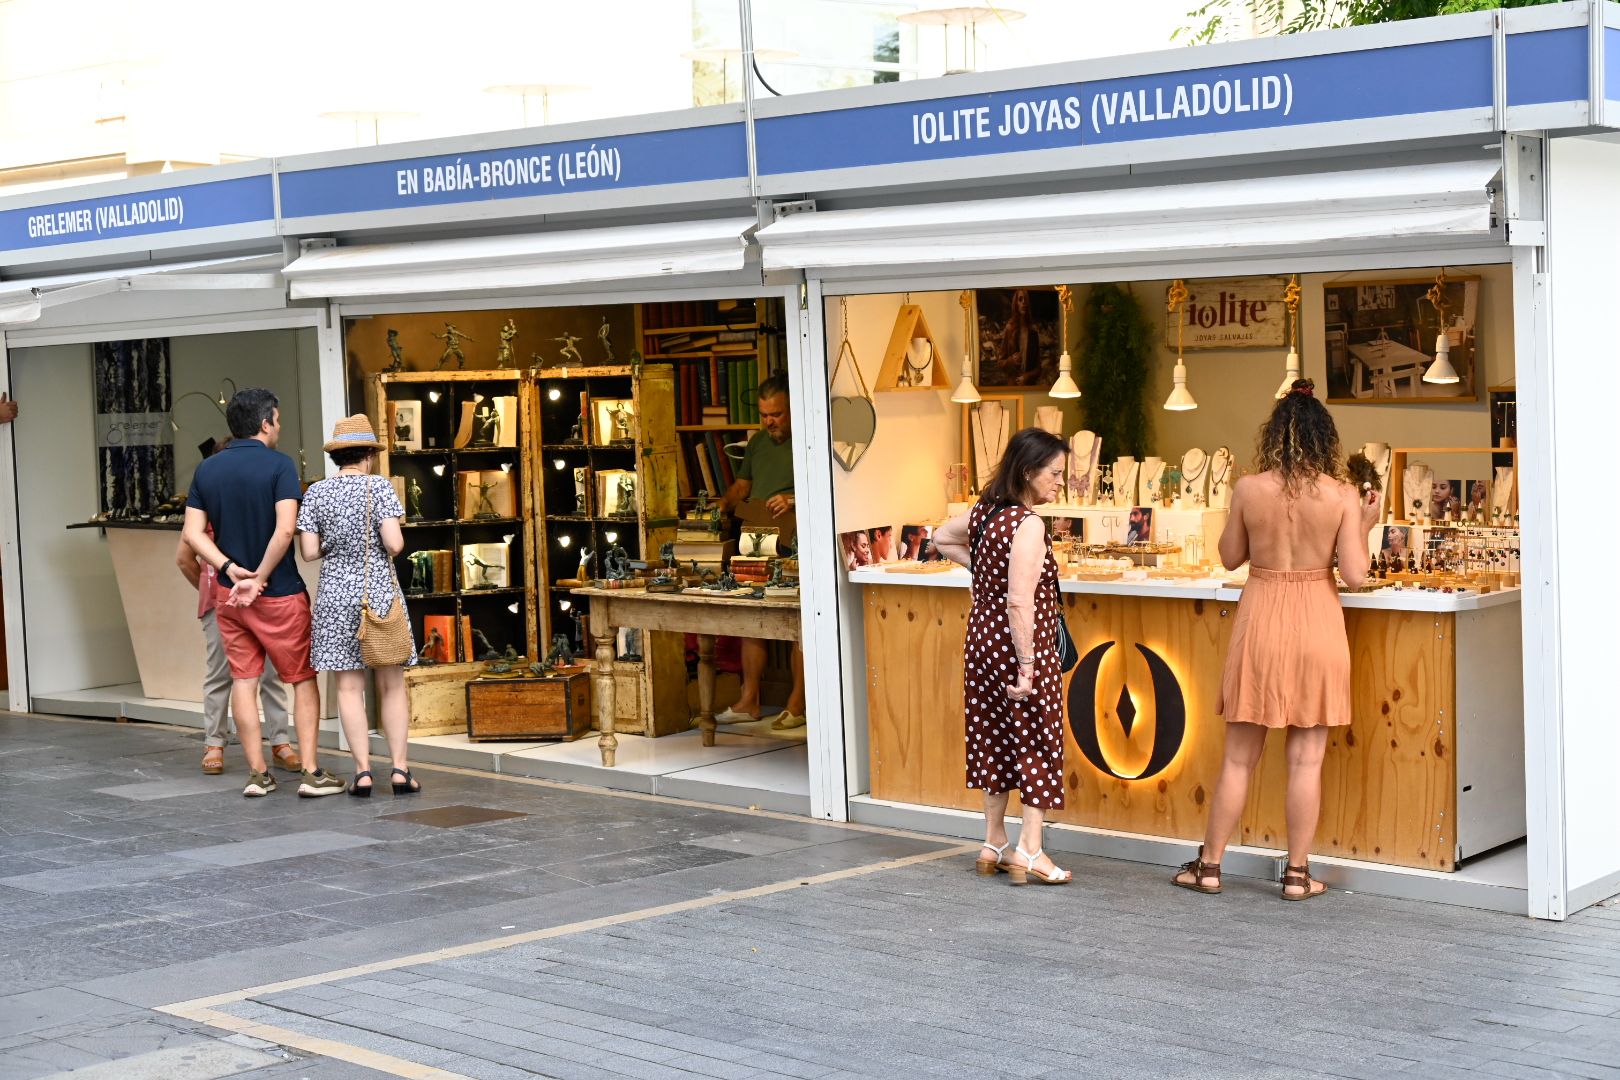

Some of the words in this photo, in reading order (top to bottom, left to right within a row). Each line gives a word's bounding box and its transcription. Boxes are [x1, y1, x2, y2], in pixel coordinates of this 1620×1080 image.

[912, 106, 990, 145] IOLITE
[998, 96, 1081, 136] JOYAS
[1091, 73, 1293, 134] (VALLADOLID)
[397, 169, 418, 195] EN
[423, 155, 552, 193] BABÍA-BRONCE
[558, 144, 621, 186] (LEÓN)
[28, 209, 92, 238] GRELEMER
[95, 196, 184, 234] (VALLADOLID)
[1188, 291, 1267, 328] iolite
